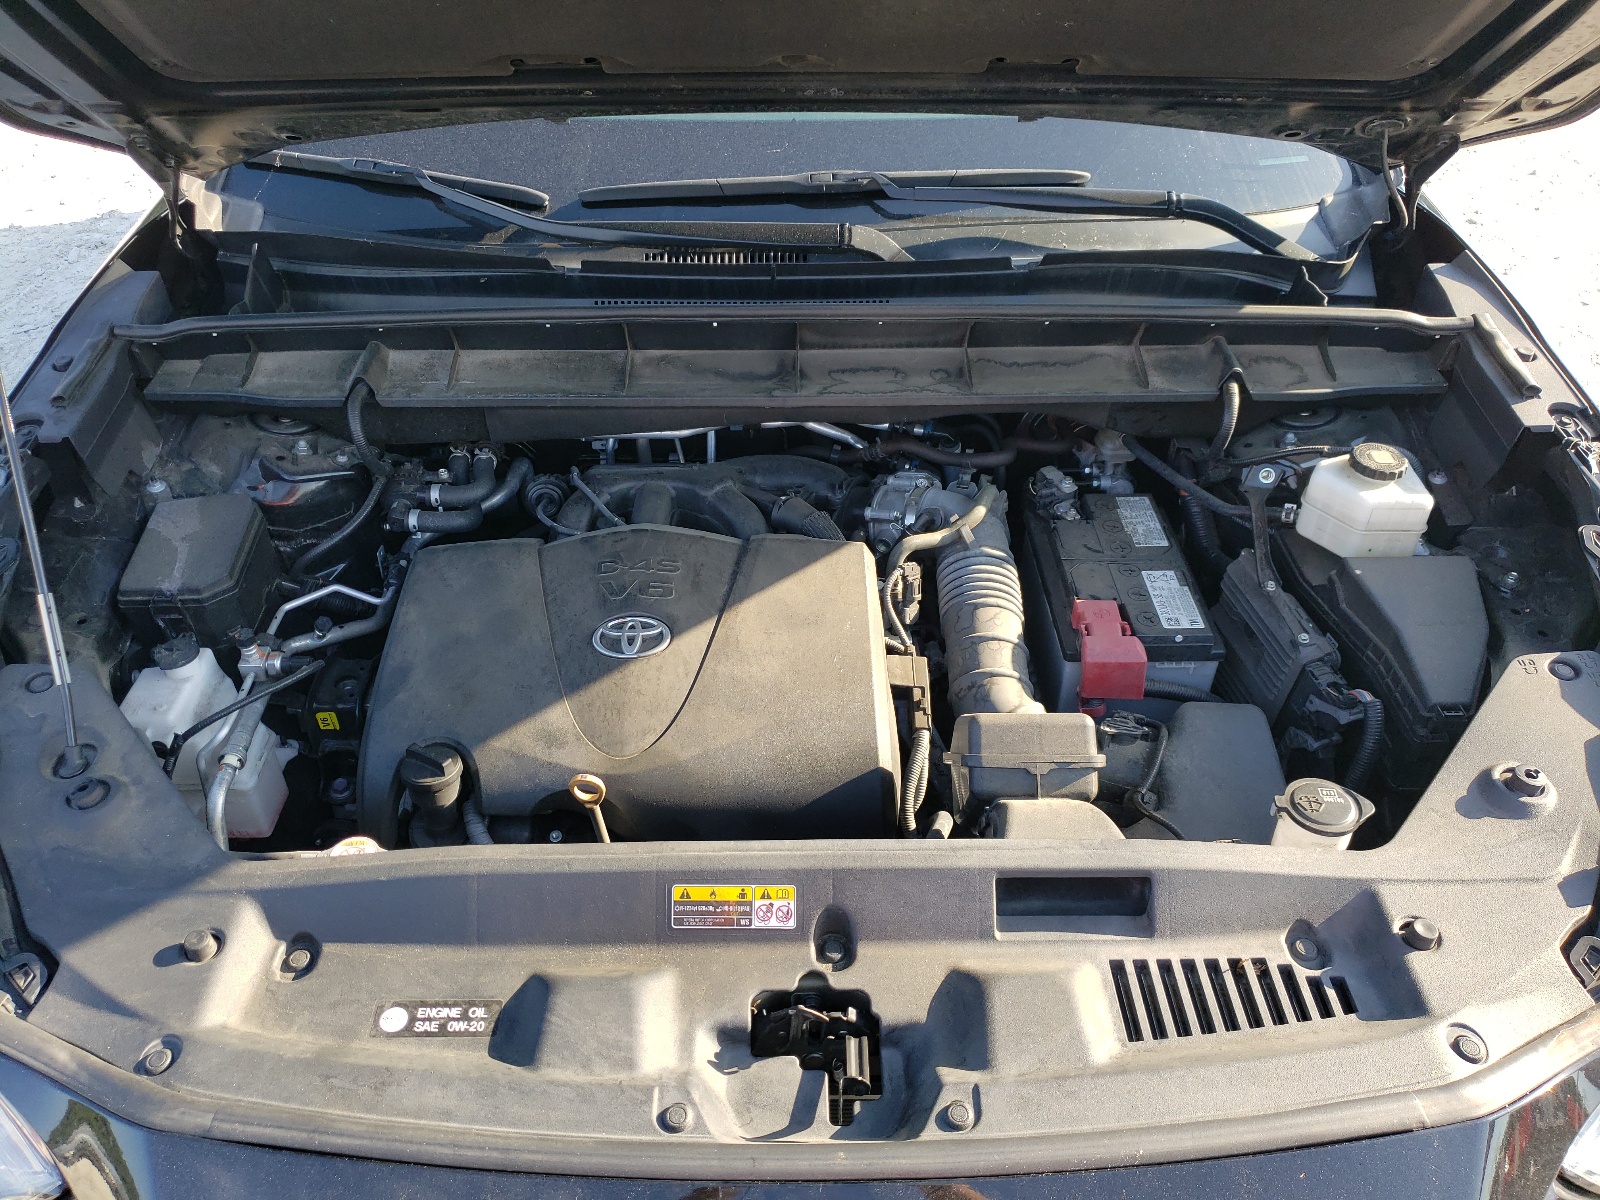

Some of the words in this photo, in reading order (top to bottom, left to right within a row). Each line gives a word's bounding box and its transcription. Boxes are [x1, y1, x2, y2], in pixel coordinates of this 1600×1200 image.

[599, 579, 676, 600] V6
[320, 718, 330, 727] V6
[417, 1007, 461, 1018] ENGINE
[468, 1006, 488, 1018] OIL
[413, 1021, 439, 1032] SAE
[447, 1021, 485, 1032] 0W-20
